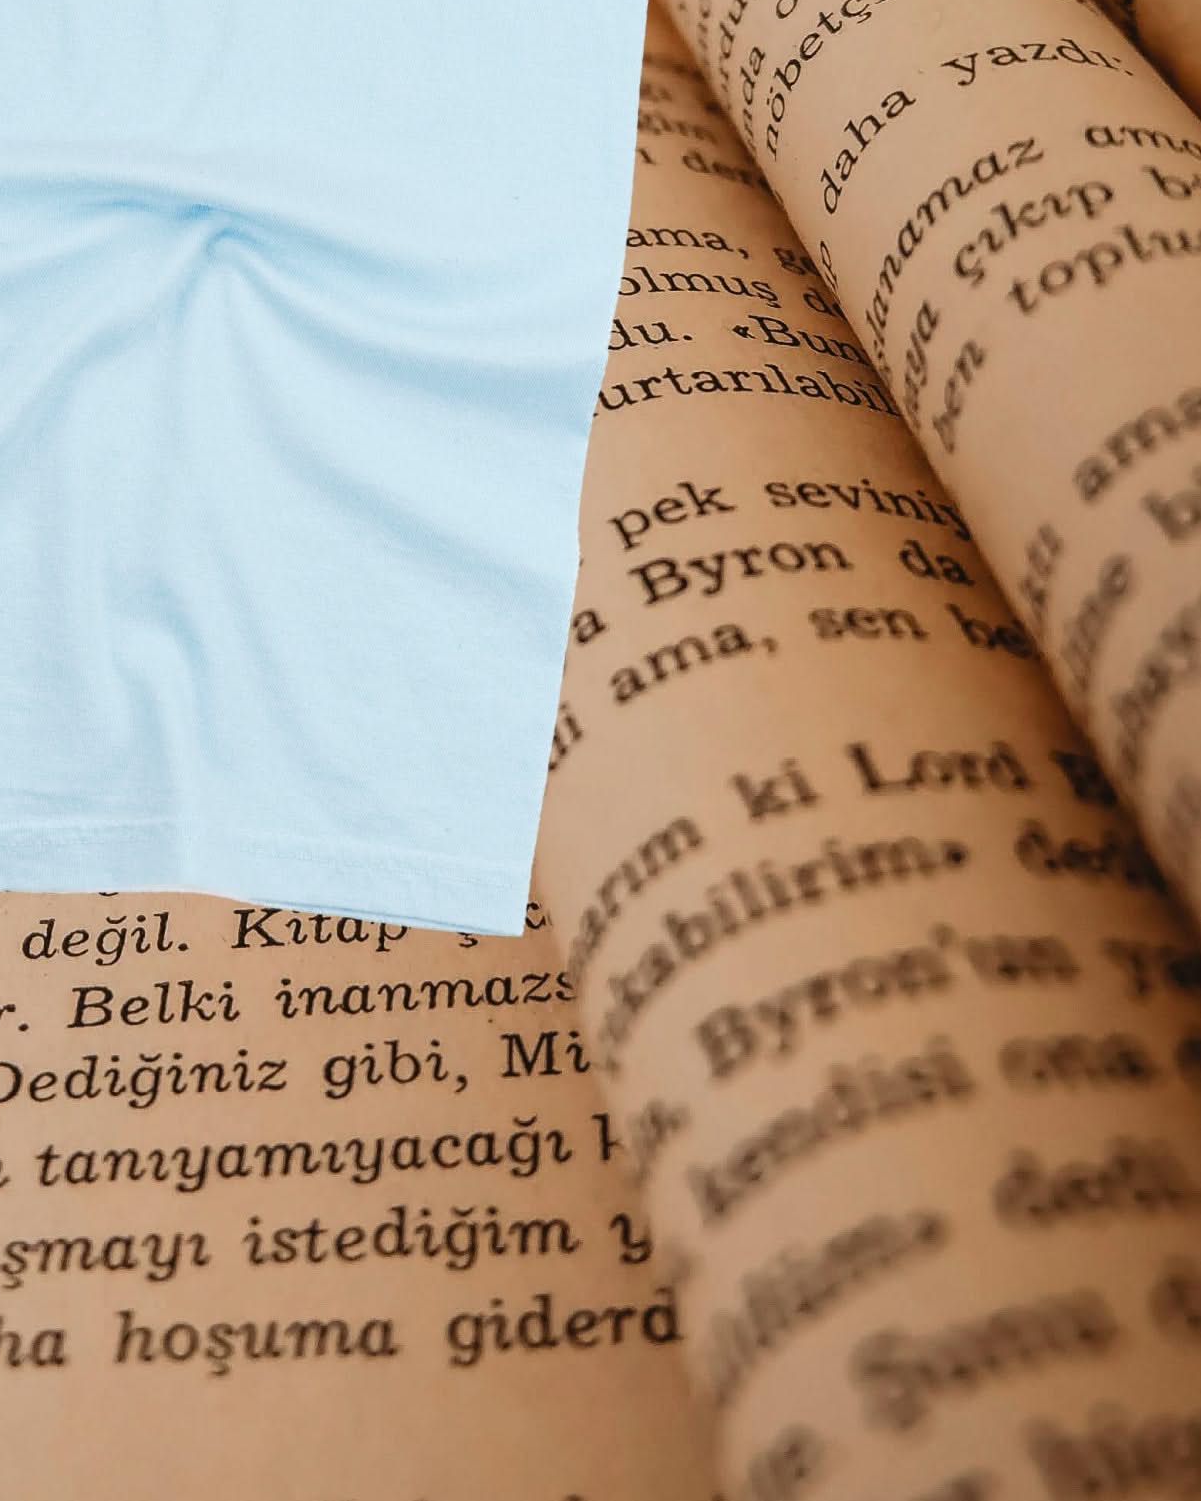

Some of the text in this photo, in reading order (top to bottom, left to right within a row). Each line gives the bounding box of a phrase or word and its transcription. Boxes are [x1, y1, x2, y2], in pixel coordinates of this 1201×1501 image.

[821, 88, 917, 215] daha
[626, 221, 749, 260] ama,
[592, 363, 900, 418] urtarılabil
[607, 480, 738, 552] pek
[626, 538, 854, 606] Byron
[898, 538, 976, 588] da
[608, 620, 780, 706] ama,
[807, 605, 931, 643] sen
[845, 738, 1035, 796] Lord
[21, 910, 191, 967] değil.
[66, 979, 241, 1029] Belki
[322, 1037, 469, 1101] gibi,
[34, 1113, 574, 1195] tanıyamıyacağı
[243, 1204, 584, 1271] istediğim
[112, 1307, 402, 1379] hoşuma
